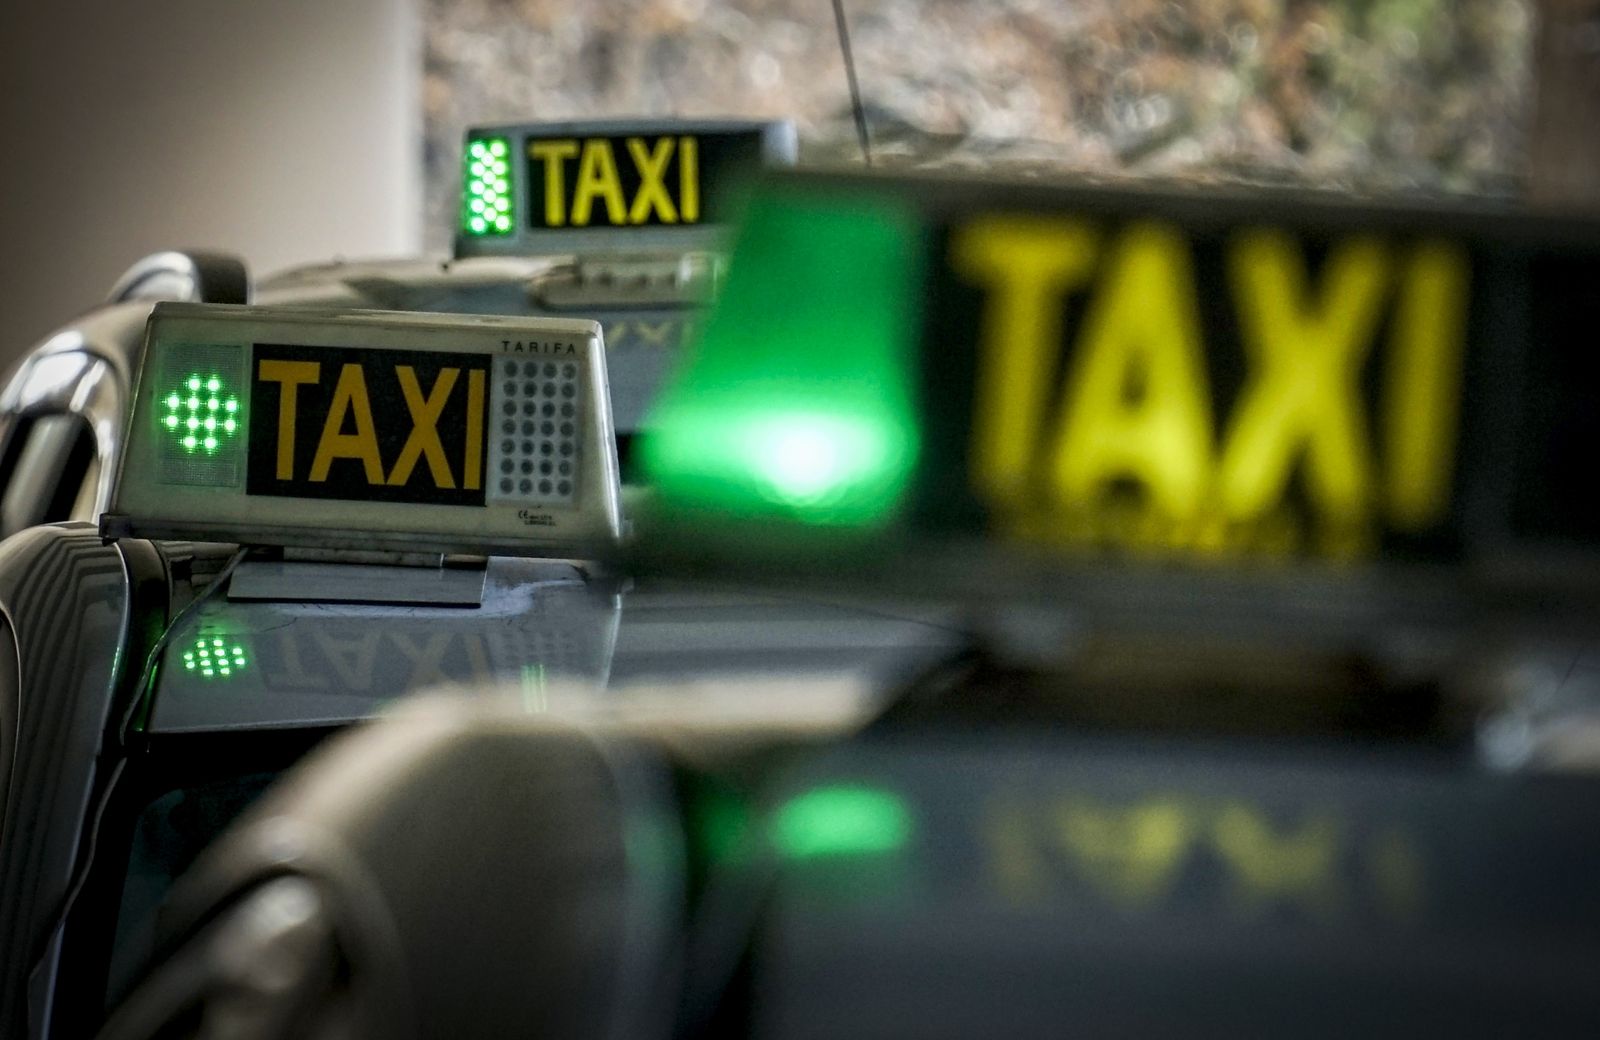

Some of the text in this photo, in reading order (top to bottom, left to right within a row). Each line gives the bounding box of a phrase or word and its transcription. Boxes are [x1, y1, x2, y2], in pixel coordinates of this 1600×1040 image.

[530, 137, 699, 227] TAXI
[501, 340, 576, 354] TARIFA
[953, 219, 1466, 526] TAXI
[258, 359, 487, 491] TAXI
